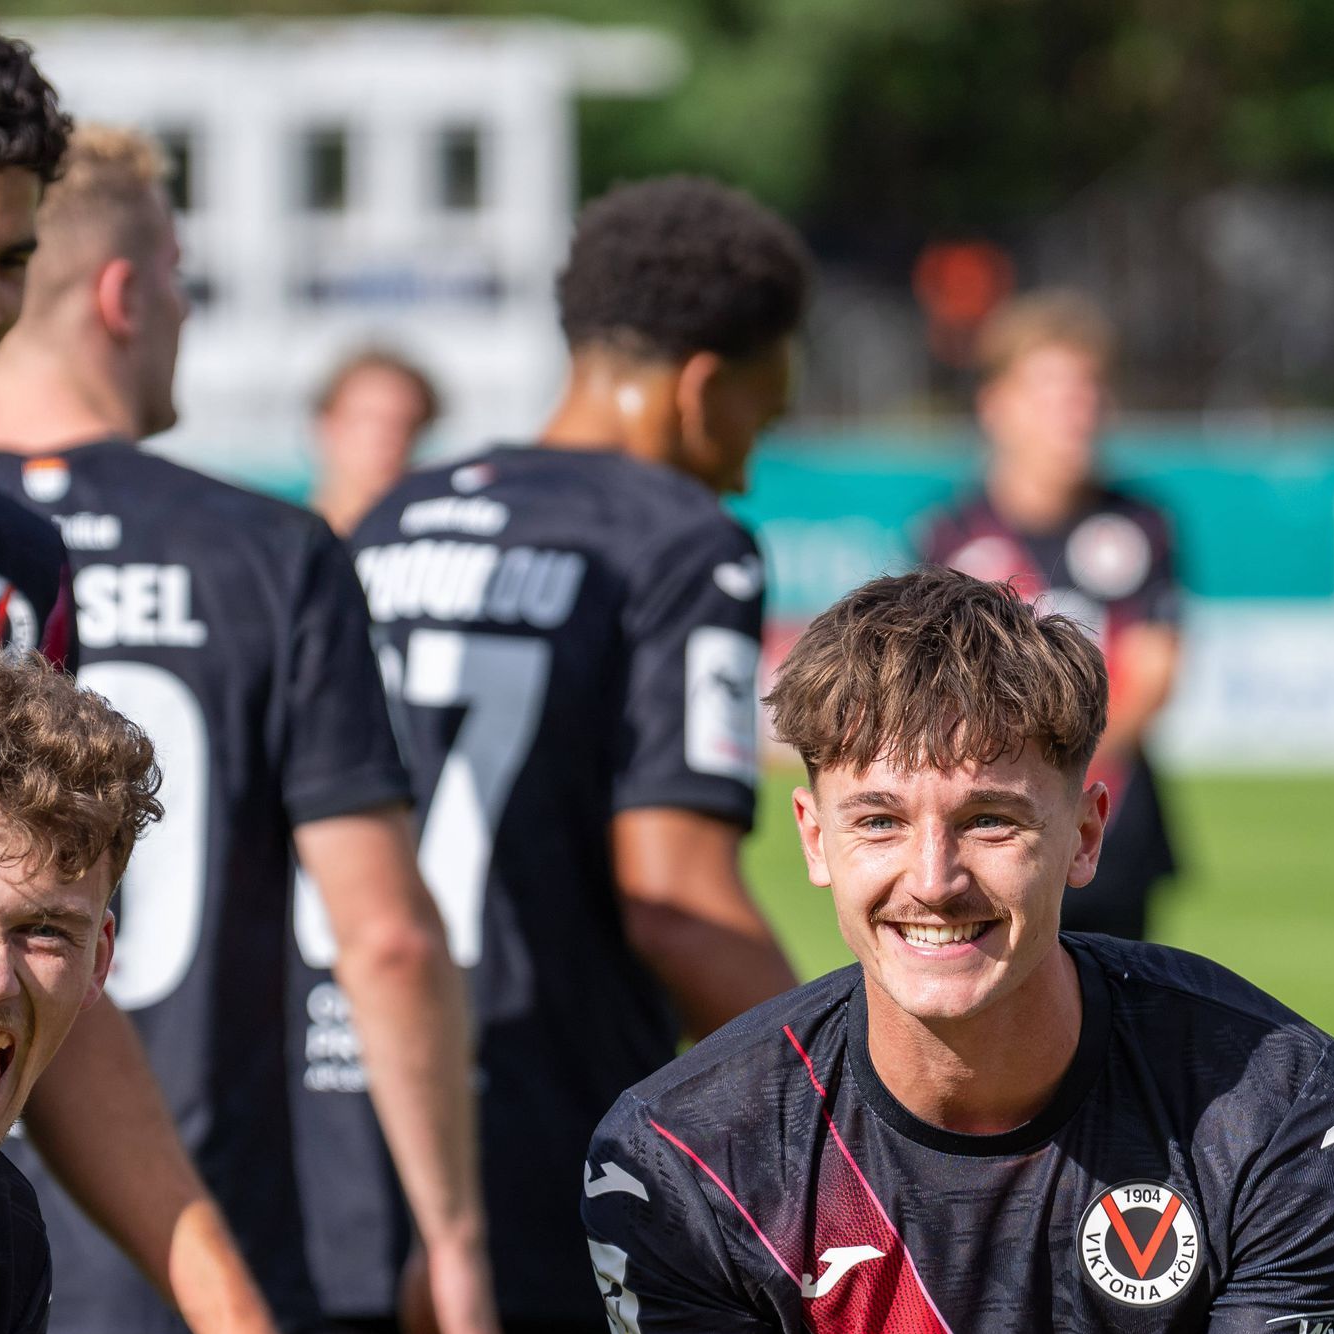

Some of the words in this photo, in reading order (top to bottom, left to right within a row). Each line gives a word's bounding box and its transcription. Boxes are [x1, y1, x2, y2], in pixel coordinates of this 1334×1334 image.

[1123, 1188, 1162, 1204] 1904
[1085, 1232, 1162, 1301] VIKTORIA
[1168, 1234, 1196, 1288] KÖLN
